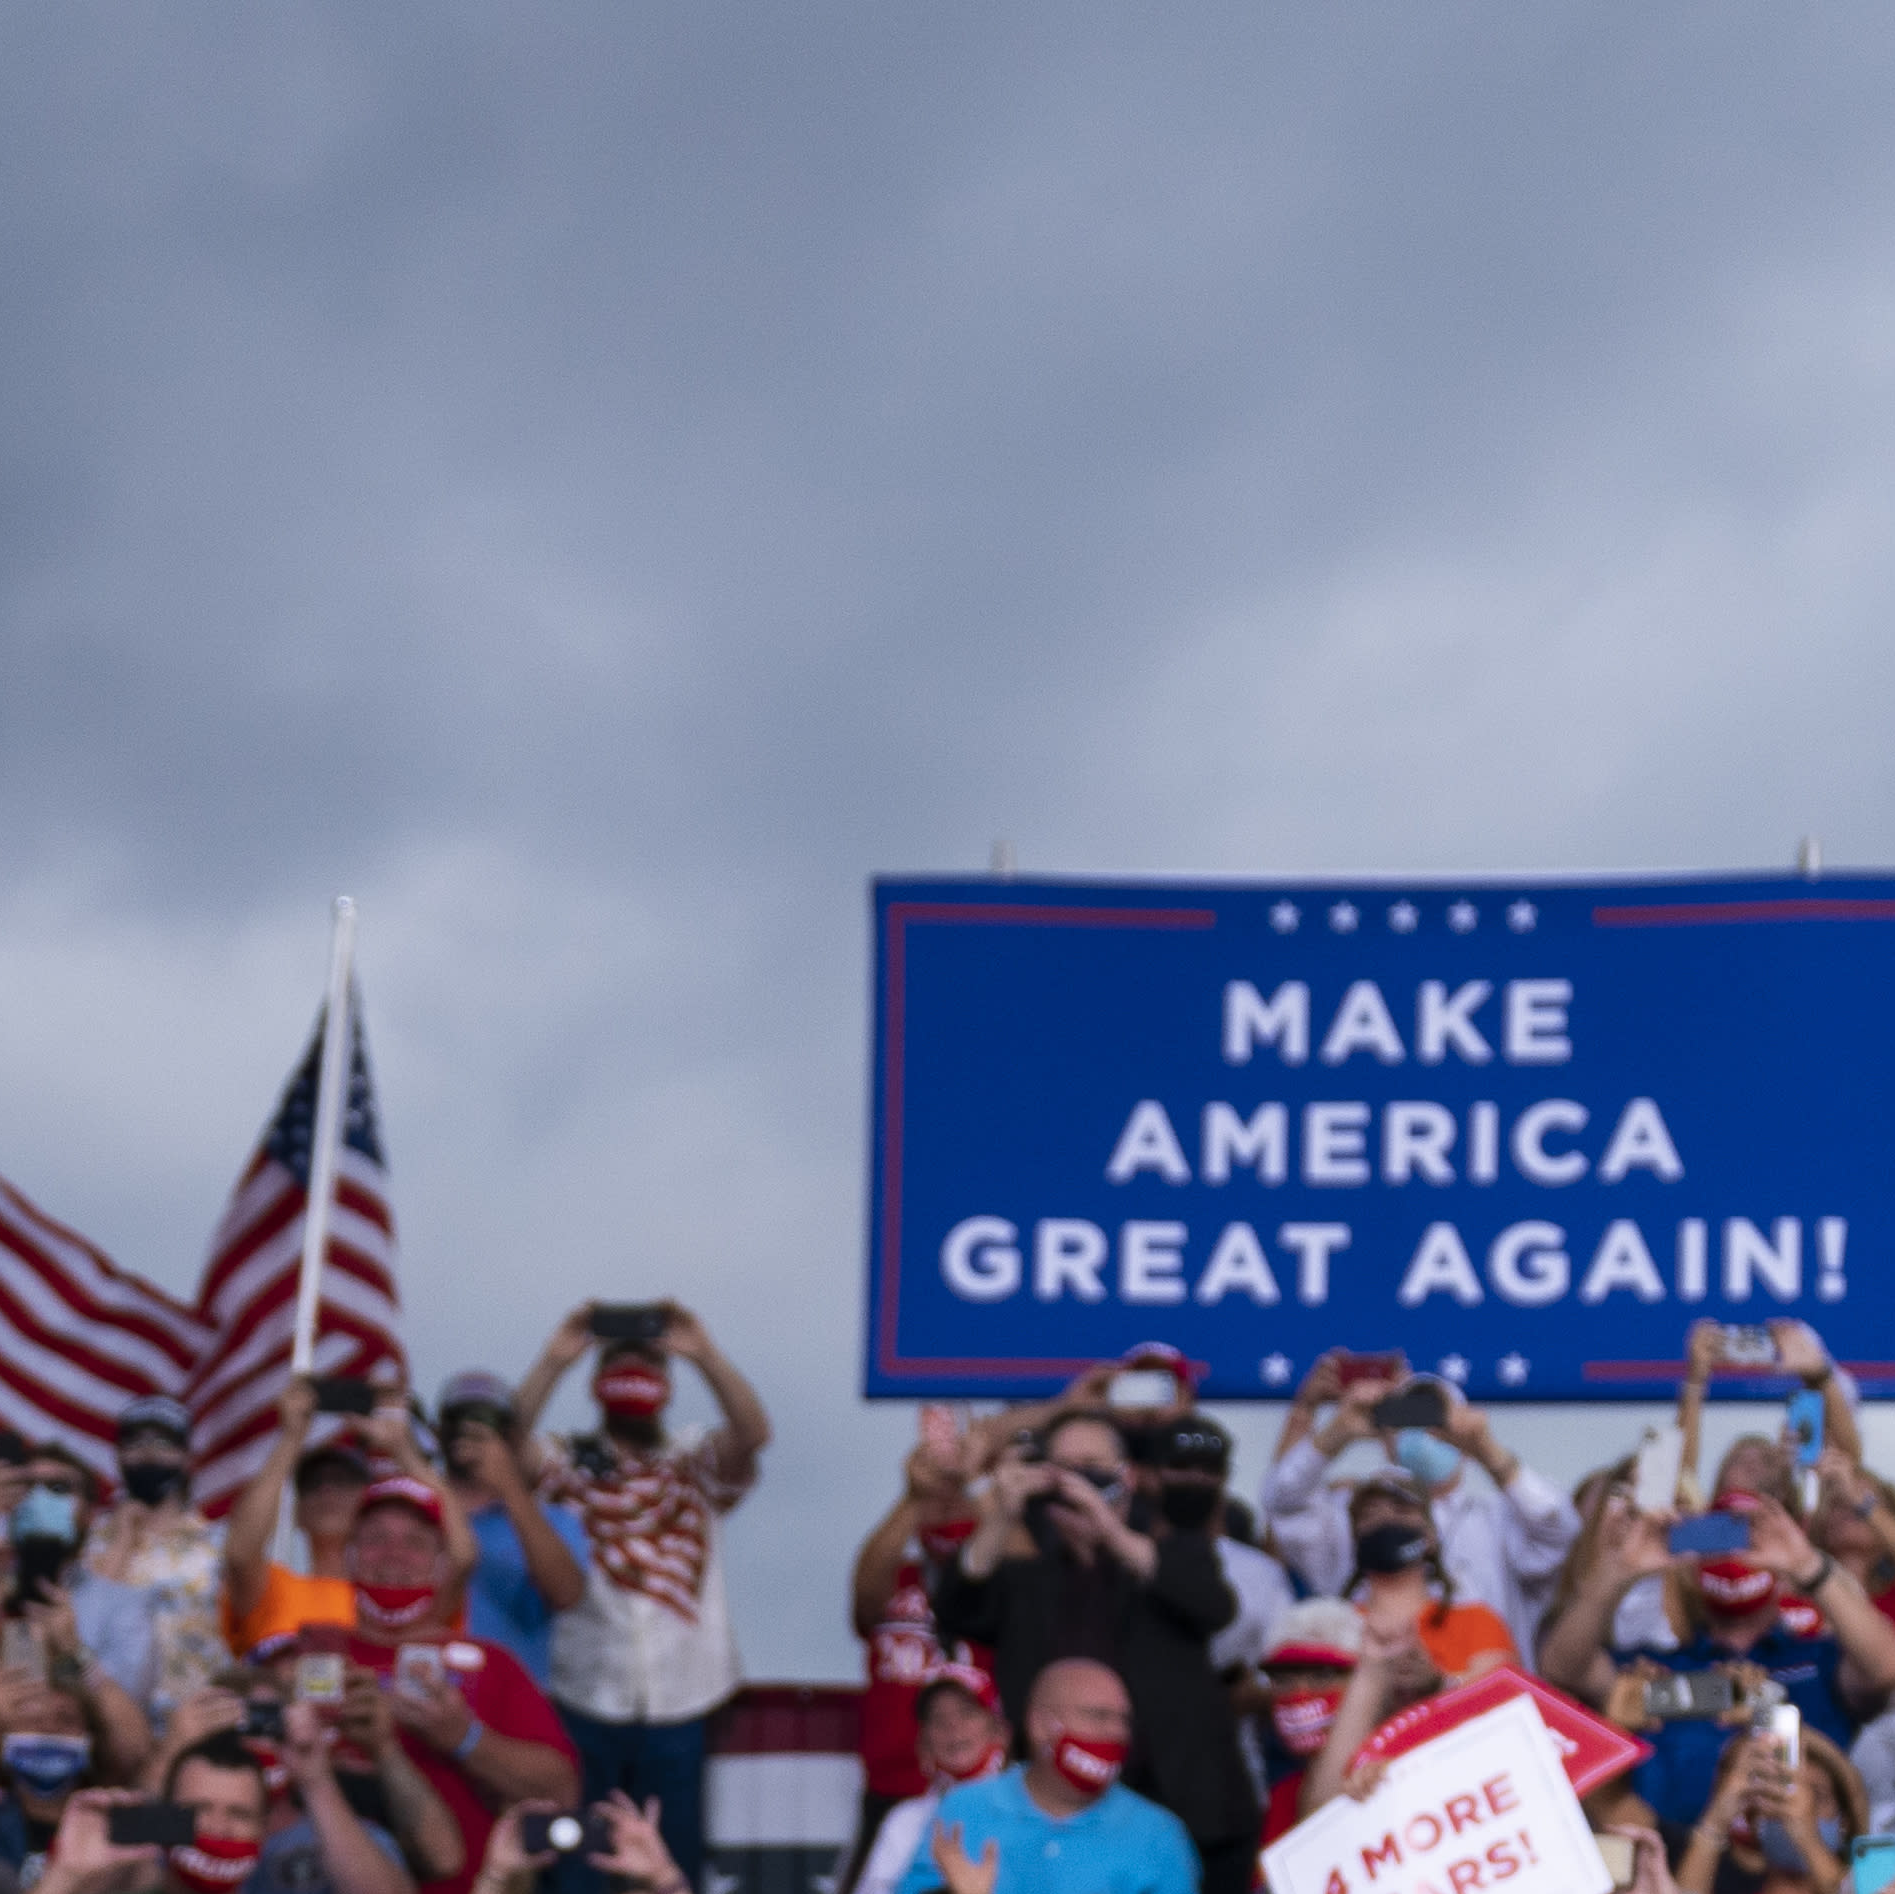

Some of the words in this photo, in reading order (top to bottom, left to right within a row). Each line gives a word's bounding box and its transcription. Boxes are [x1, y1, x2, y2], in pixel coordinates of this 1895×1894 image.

[1222, 978, 1574, 1064] MAKE
[1105, 1097, 1684, 1188] AMERICA
[939, 1216, 1353, 1307] GREAT
[1396, 1216, 1850, 1307] AGAIN!
[1359, 1773, 1523, 1881] MORE
